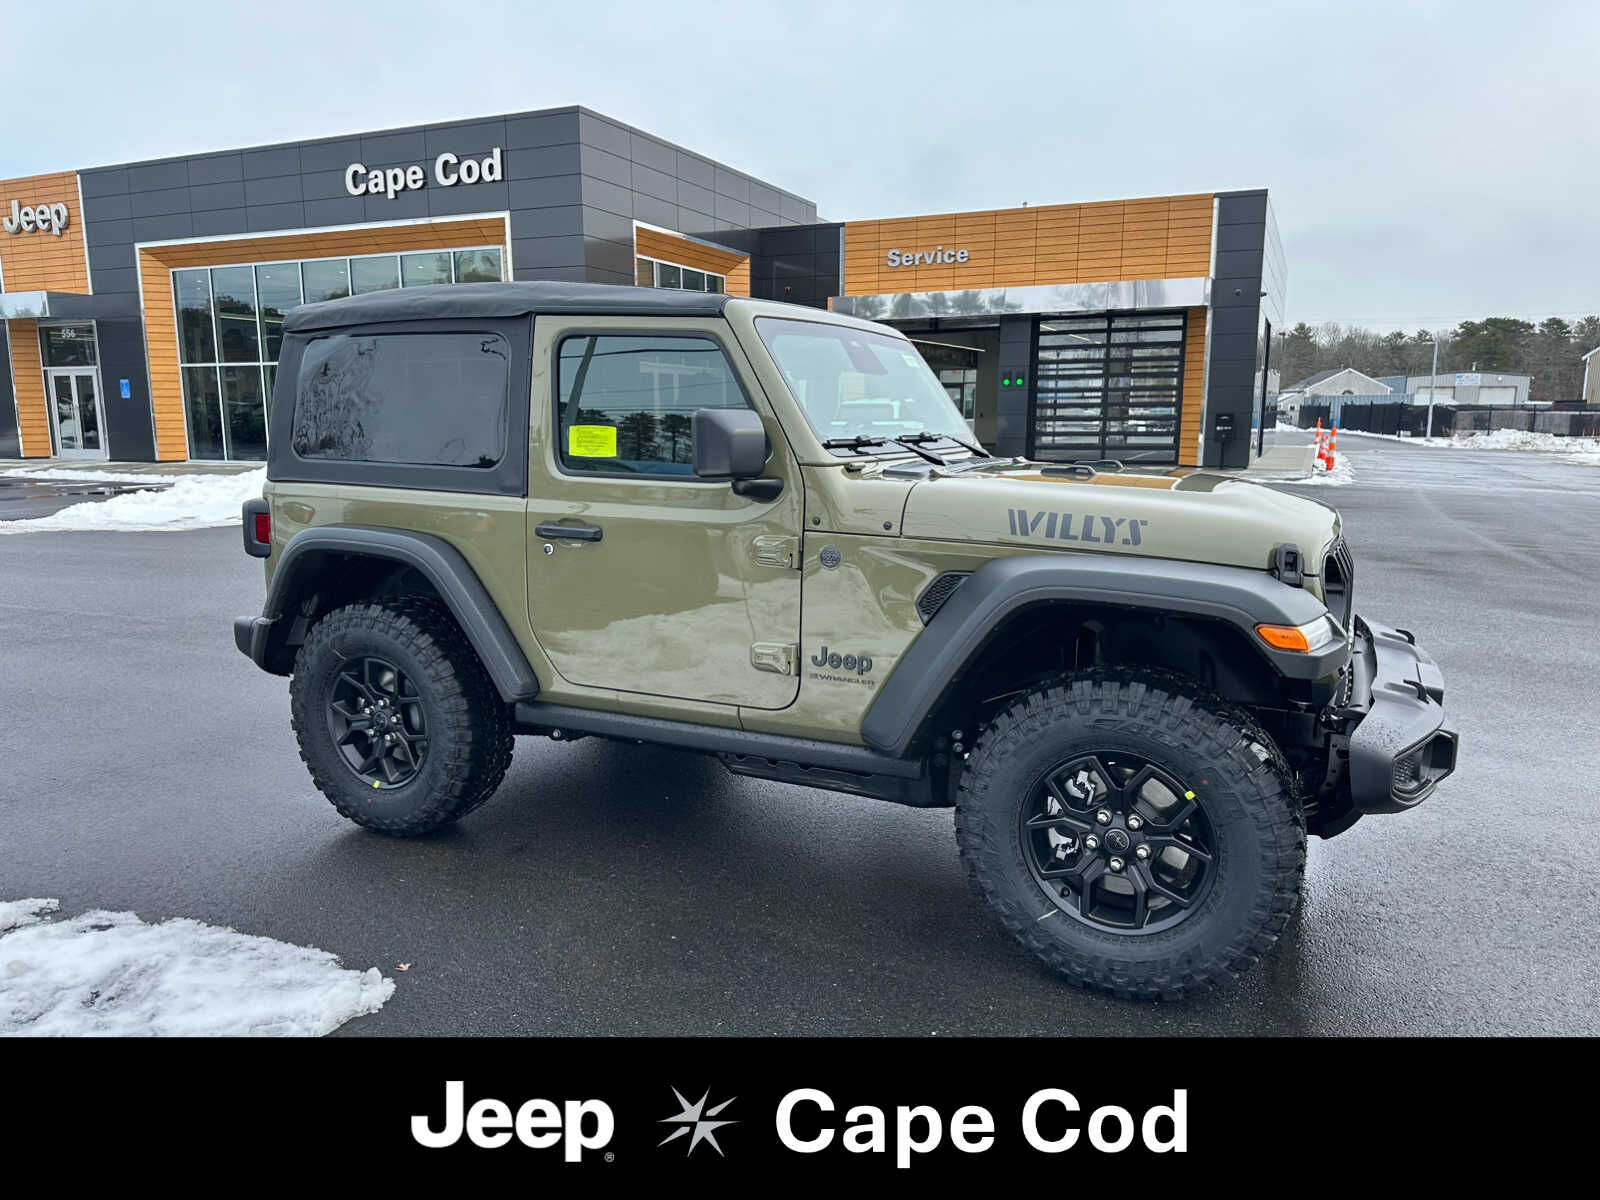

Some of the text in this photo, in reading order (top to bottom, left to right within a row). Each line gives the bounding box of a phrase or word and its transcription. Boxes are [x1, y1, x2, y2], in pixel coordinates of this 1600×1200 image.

[345, 147, 503, 199] Cape Cod
[2, 199, 69, 237] Jeep
[887, 245, 969, 267] Service
[1007, 508, 1148, 546] WILLYS
[811, 646, 873, 675] Jeep
